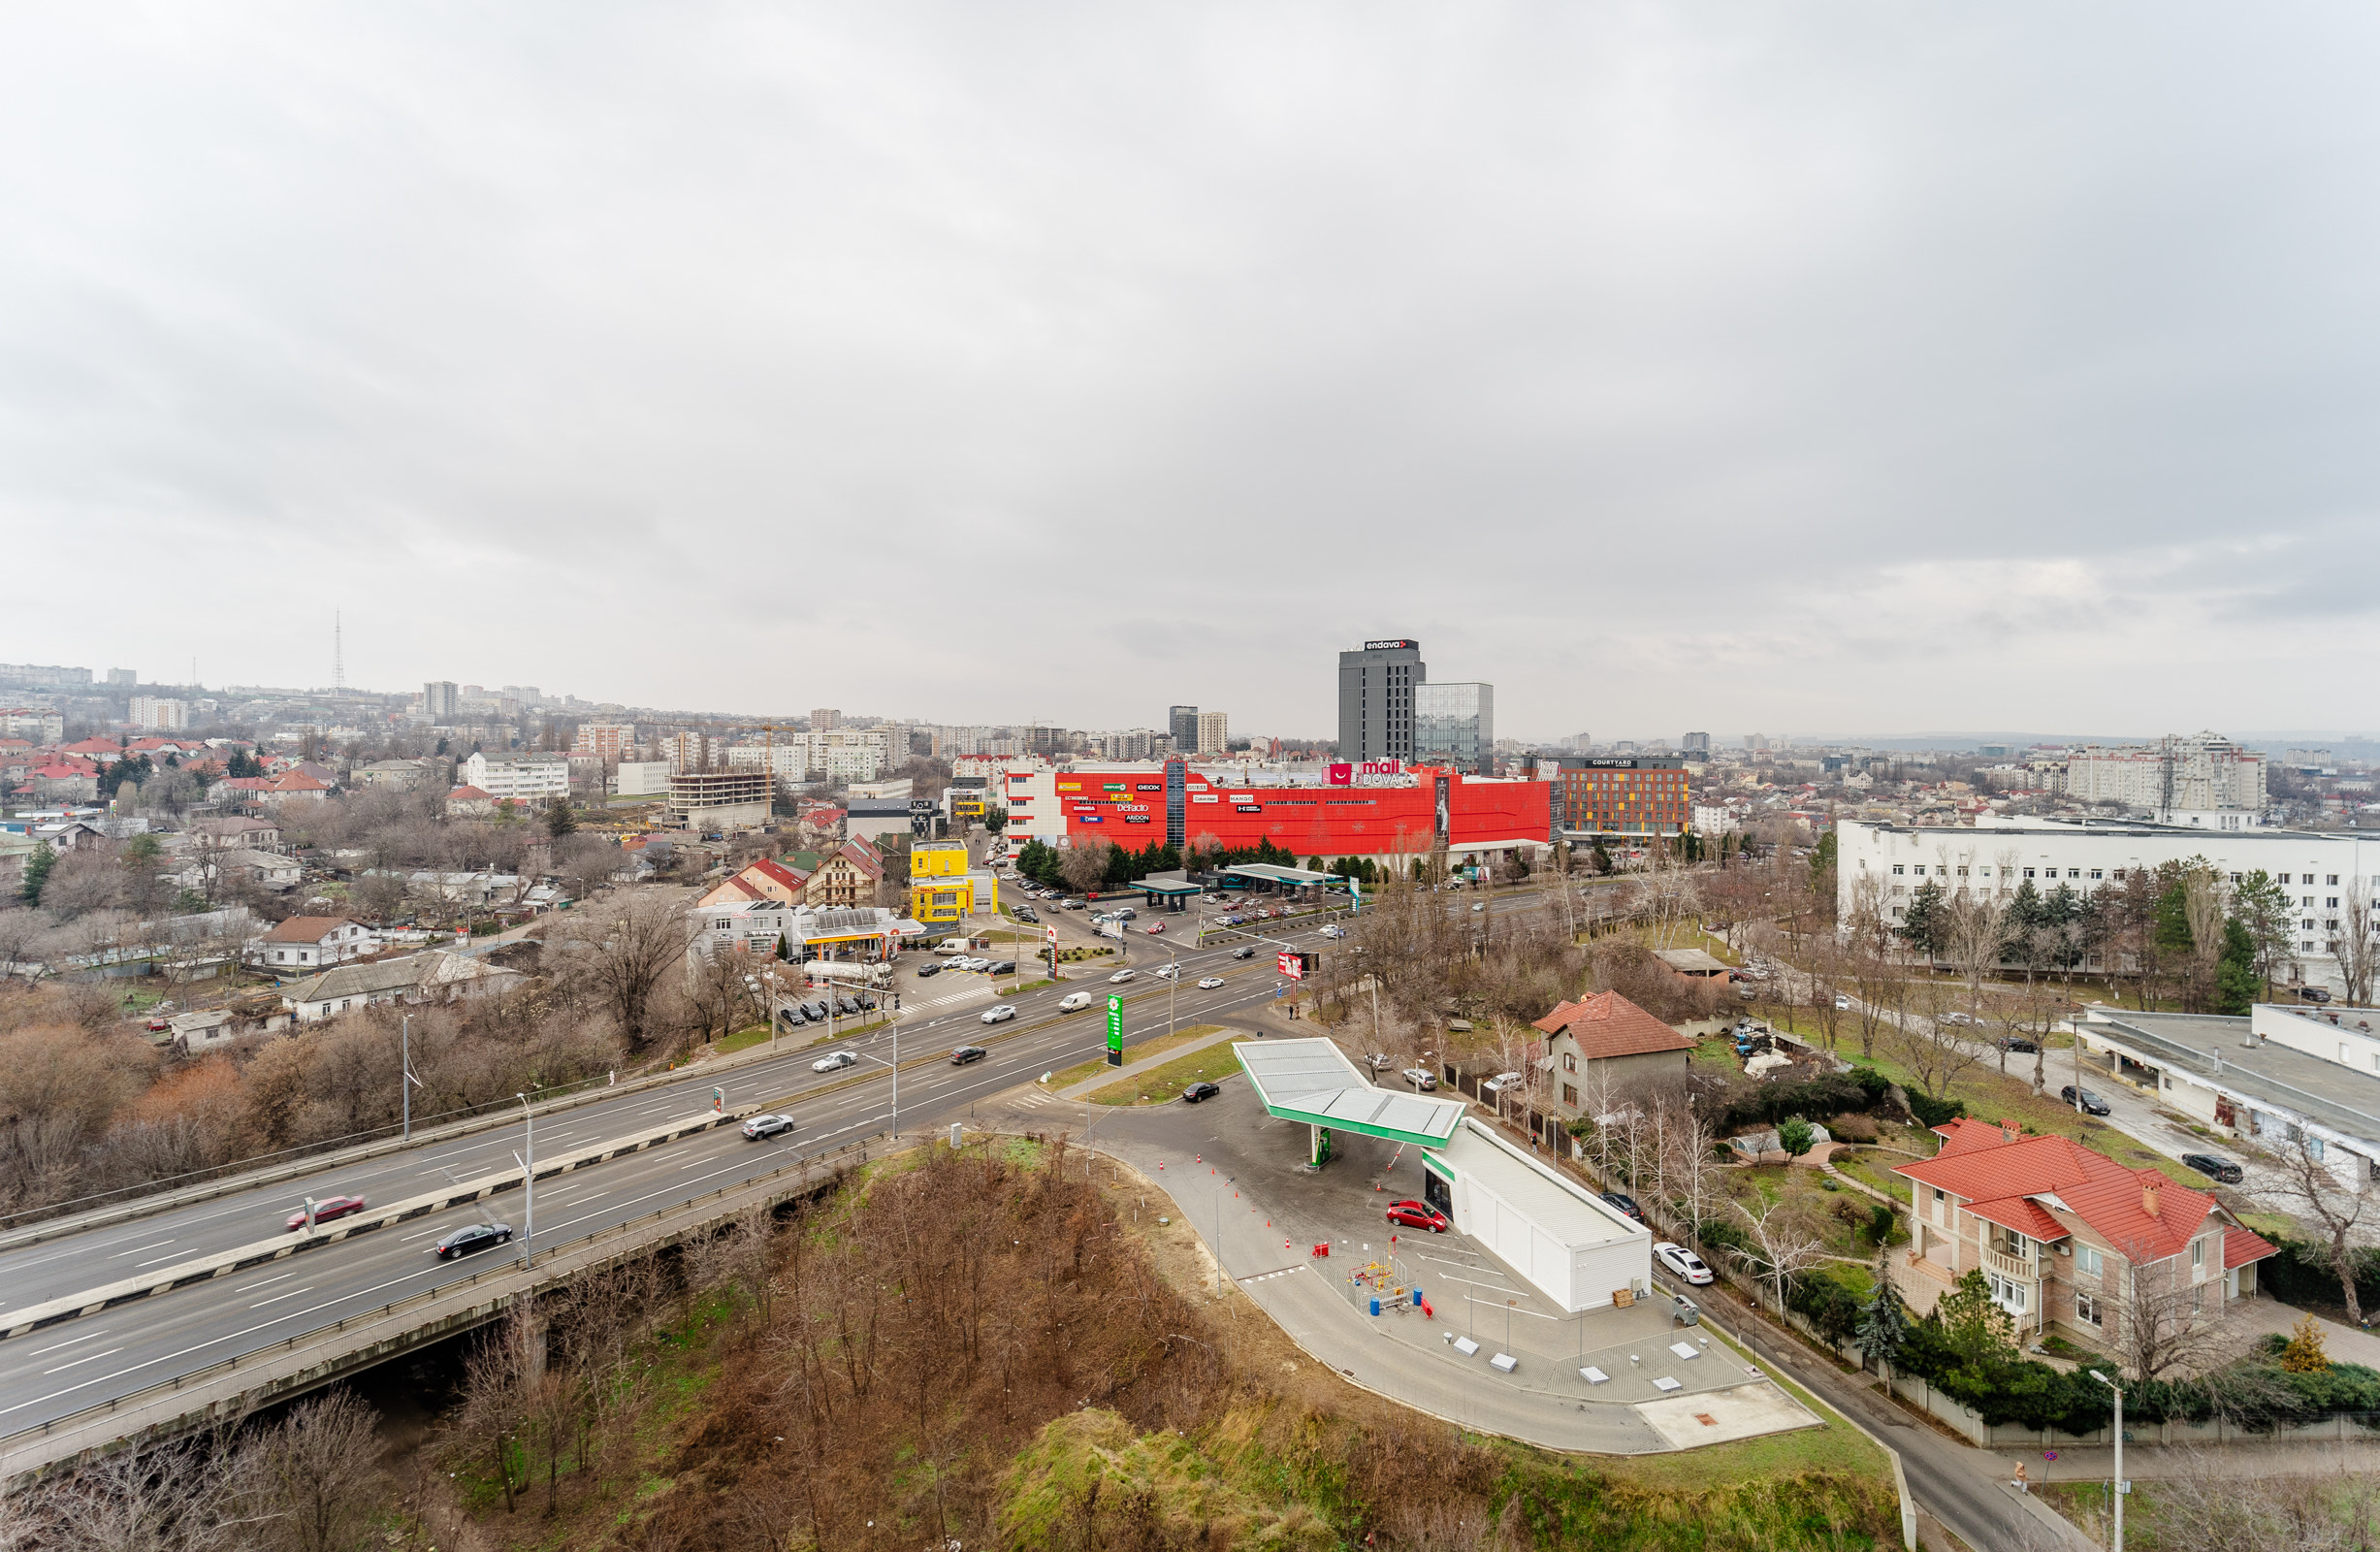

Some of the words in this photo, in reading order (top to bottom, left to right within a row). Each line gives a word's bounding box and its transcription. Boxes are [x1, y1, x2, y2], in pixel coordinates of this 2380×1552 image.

[1367, 640, 1400, 649] endava
[1363, 759, 1399, 774] mall
[1363, 773, 1399, 785] DOVA
[1117, 803, 1148, 812] DeFacto
